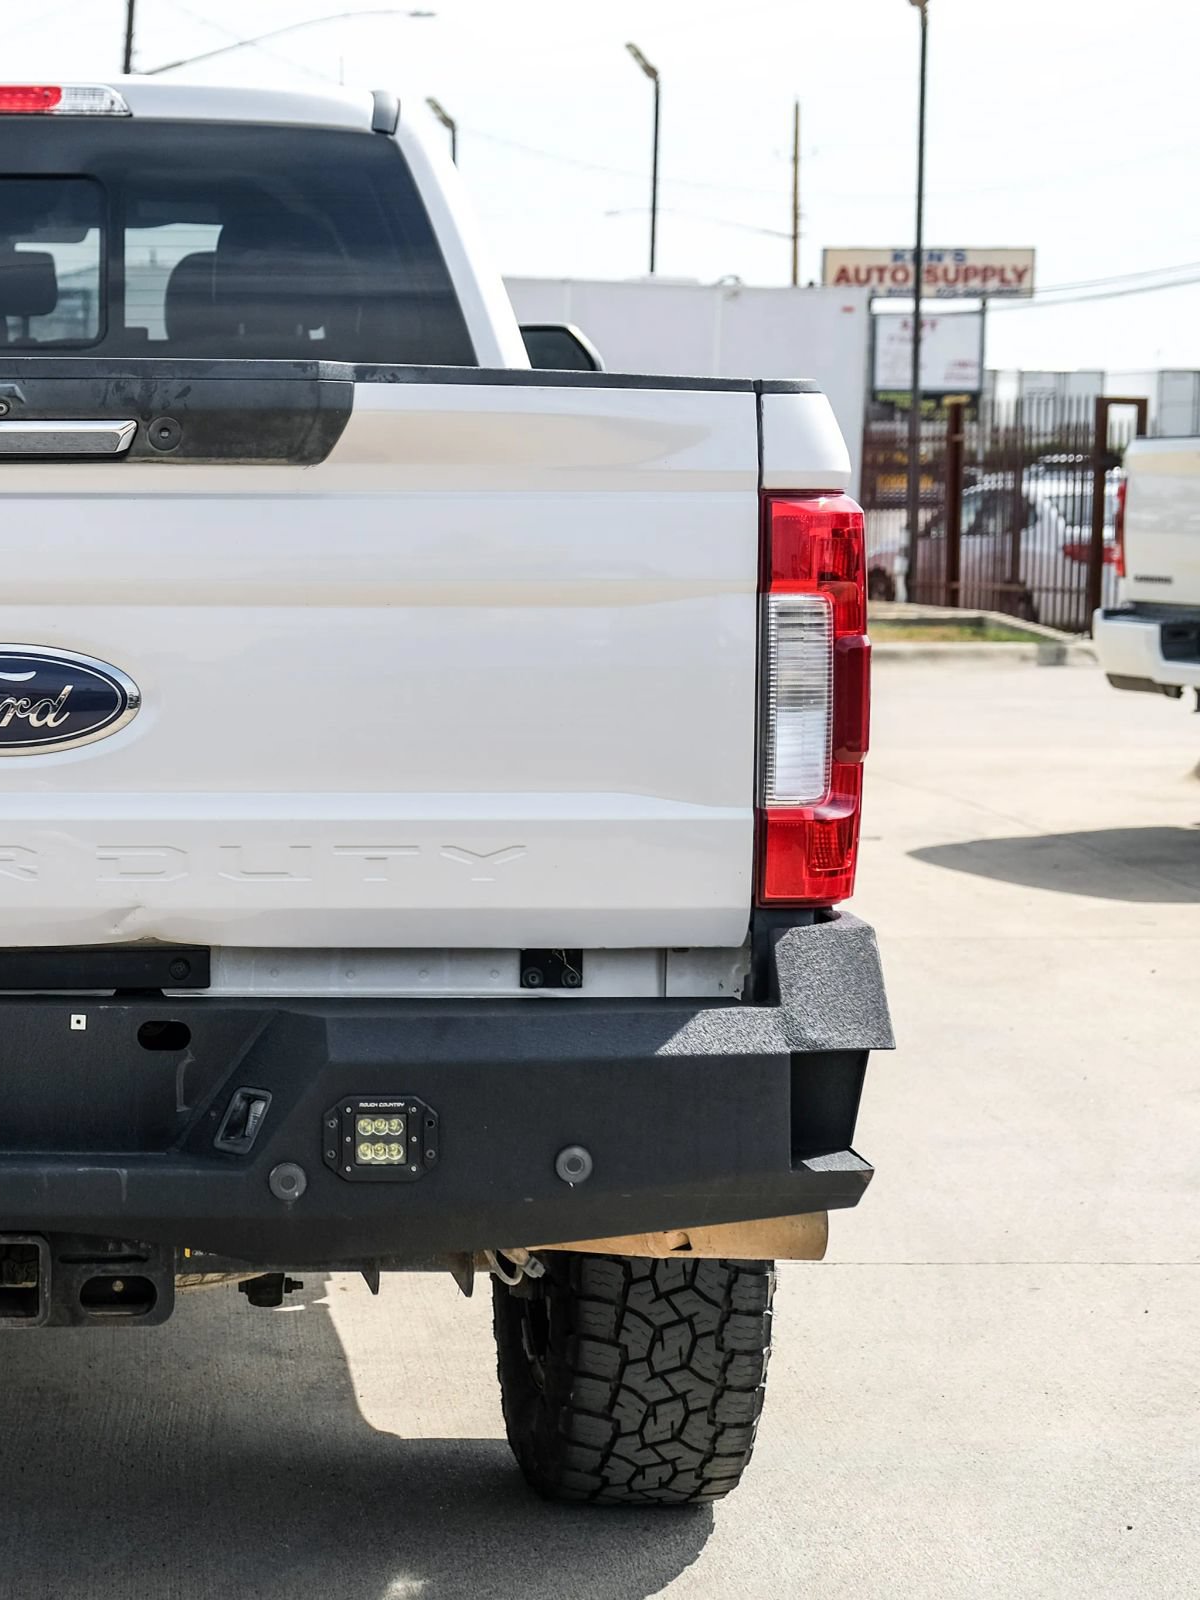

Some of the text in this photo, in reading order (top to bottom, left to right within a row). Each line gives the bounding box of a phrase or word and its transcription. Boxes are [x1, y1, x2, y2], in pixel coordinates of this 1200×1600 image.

[834, 264, 1030, 286] AUTO SUPPLY
[96, 845, 528, 882] DUTY
